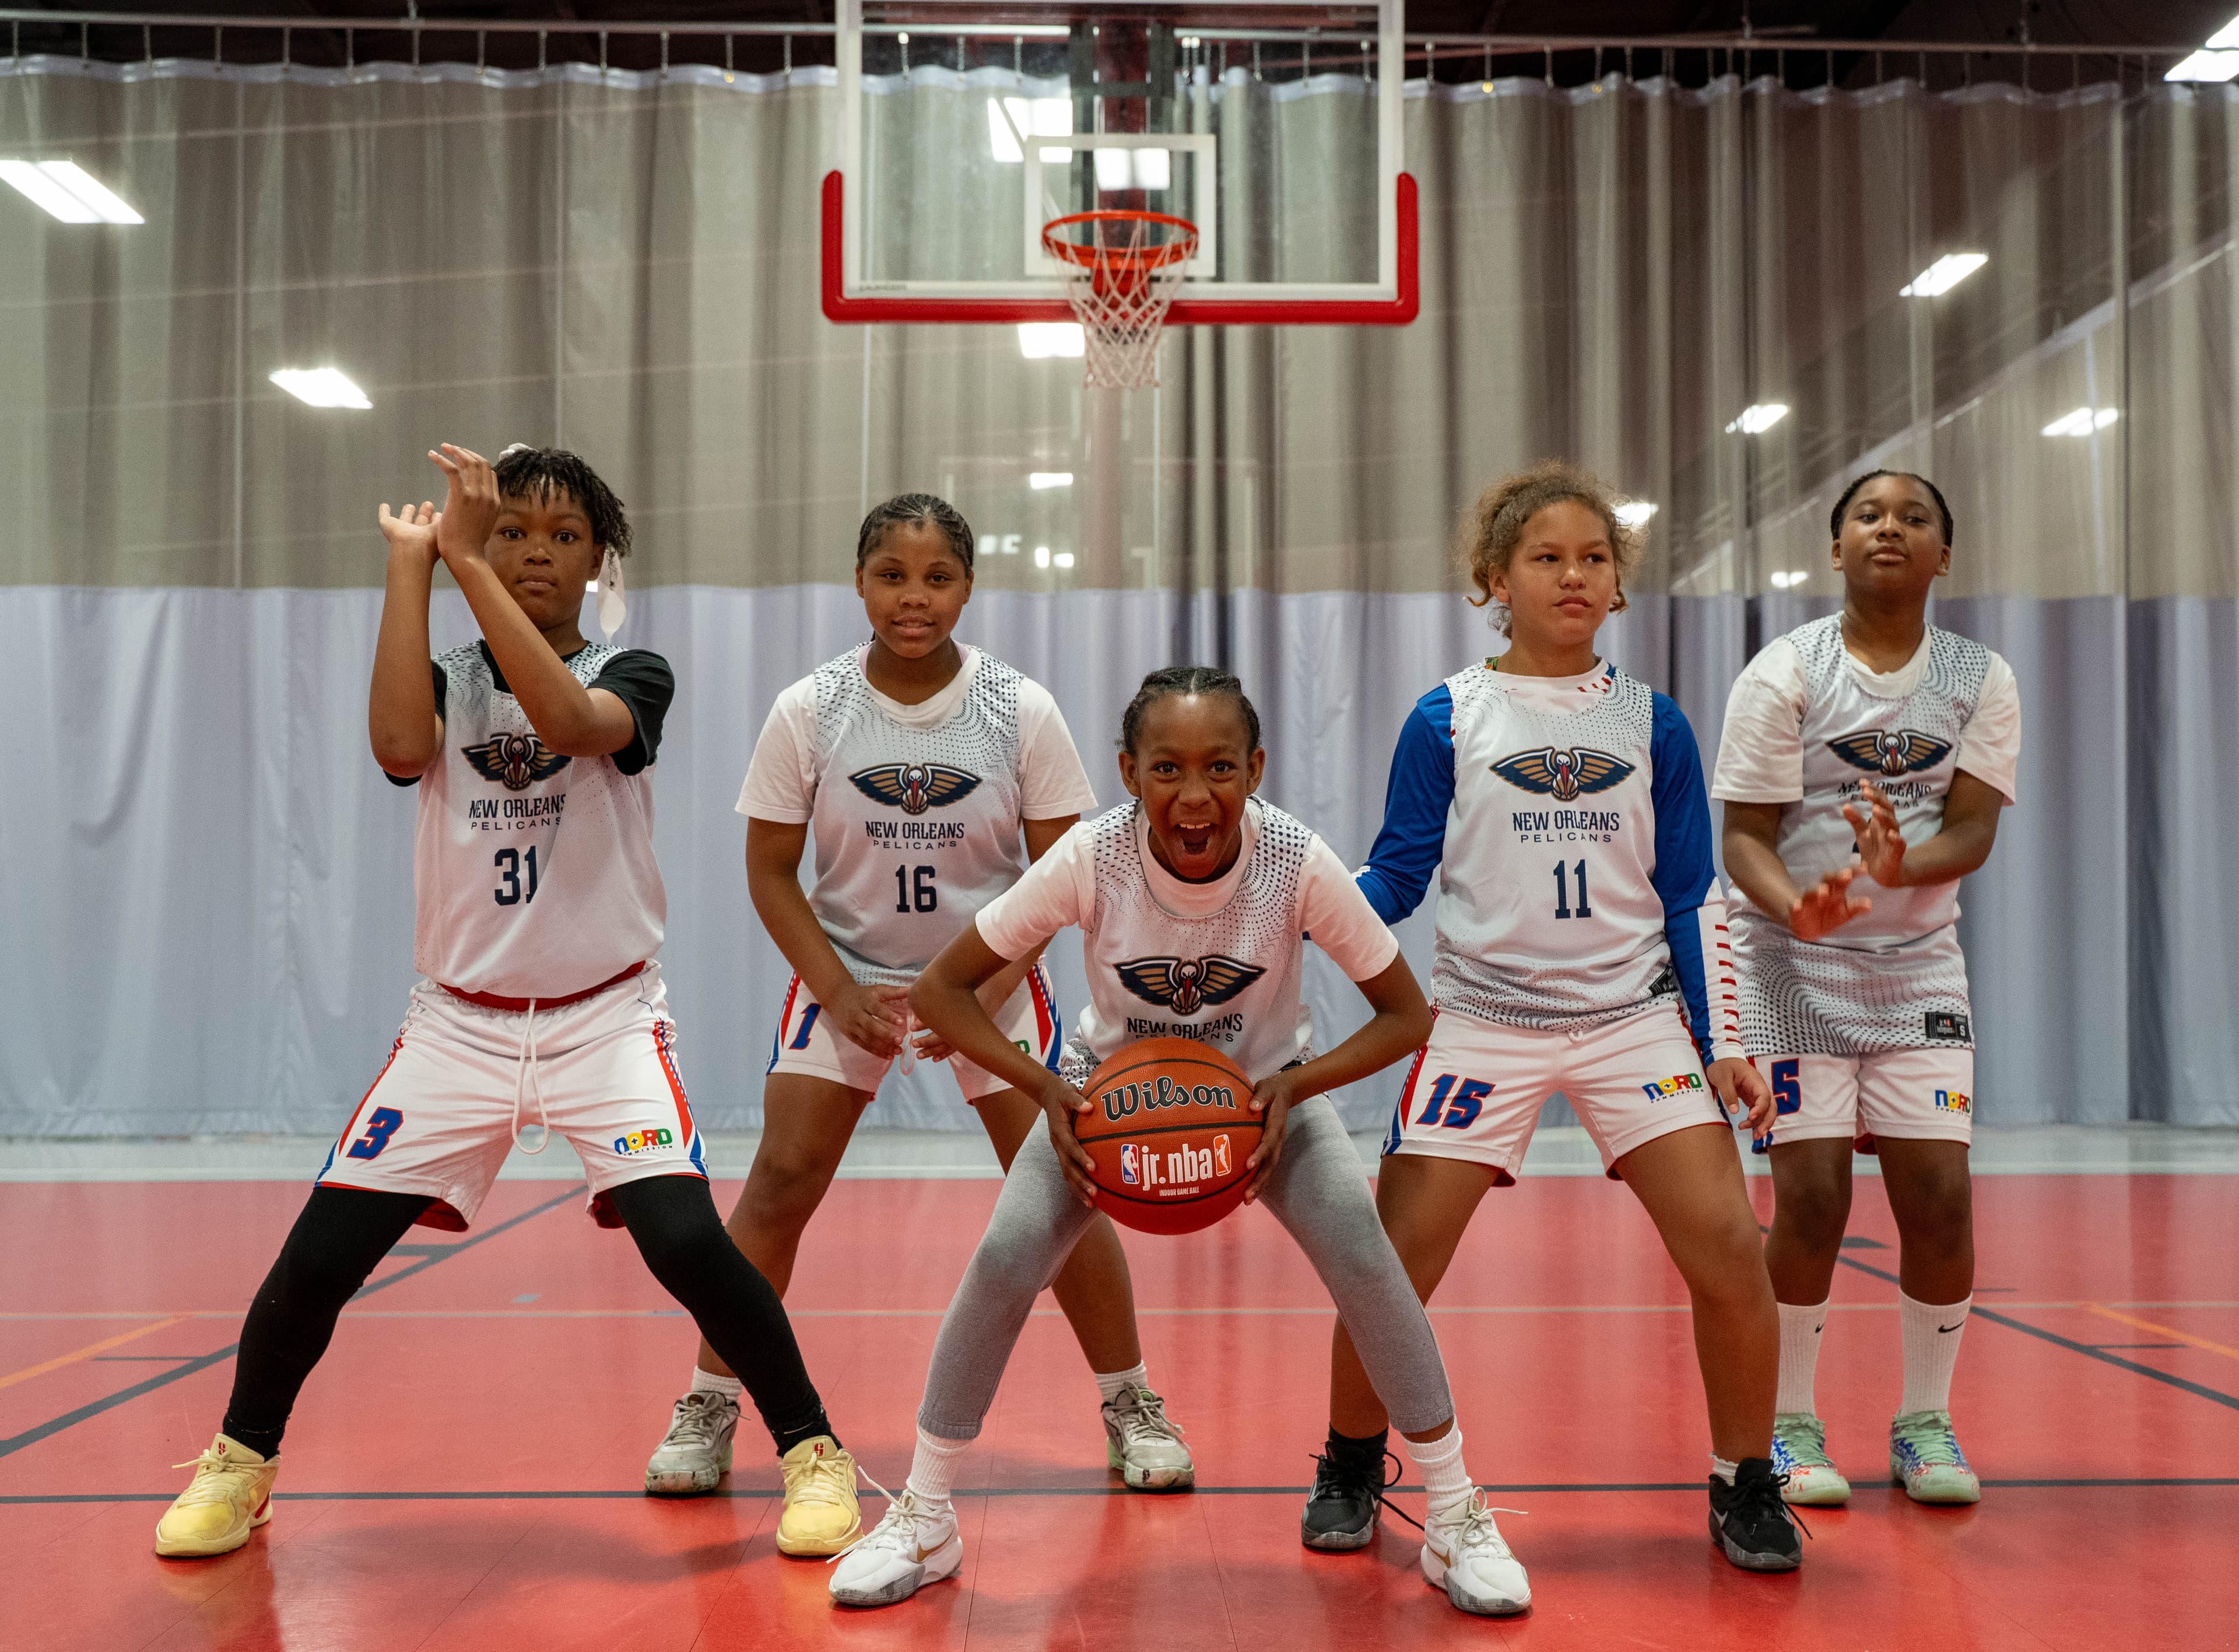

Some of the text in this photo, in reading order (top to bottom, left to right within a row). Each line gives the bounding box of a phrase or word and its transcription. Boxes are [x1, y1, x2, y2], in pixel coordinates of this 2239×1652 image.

[469, 794, 566, 818] NEW ORLEANS
[471, 816, 561, 830] PELICANS
[865, 821, 964, 840] NEW ORLEANS
[1512, 810, 1620, 832] NEW ORLEANS
[873, 840, 957, 850] PELICANS
[1521, 832, 1612, 843] PELICANS
[494, 846, 538, 906] 31
[896, 864, 938, 913] 16
[1553, 859, 1592, 920] 11
[1126, 1013, 1243, 1040] NEW ORLEANS
[1101, 1076, 1237, 1123] Wilson
[1415, 1073, 1497, 1130] 15
[346, 1106, 404, 1160] 3
[1159, 1188, 1177, 1197] INDOOR
